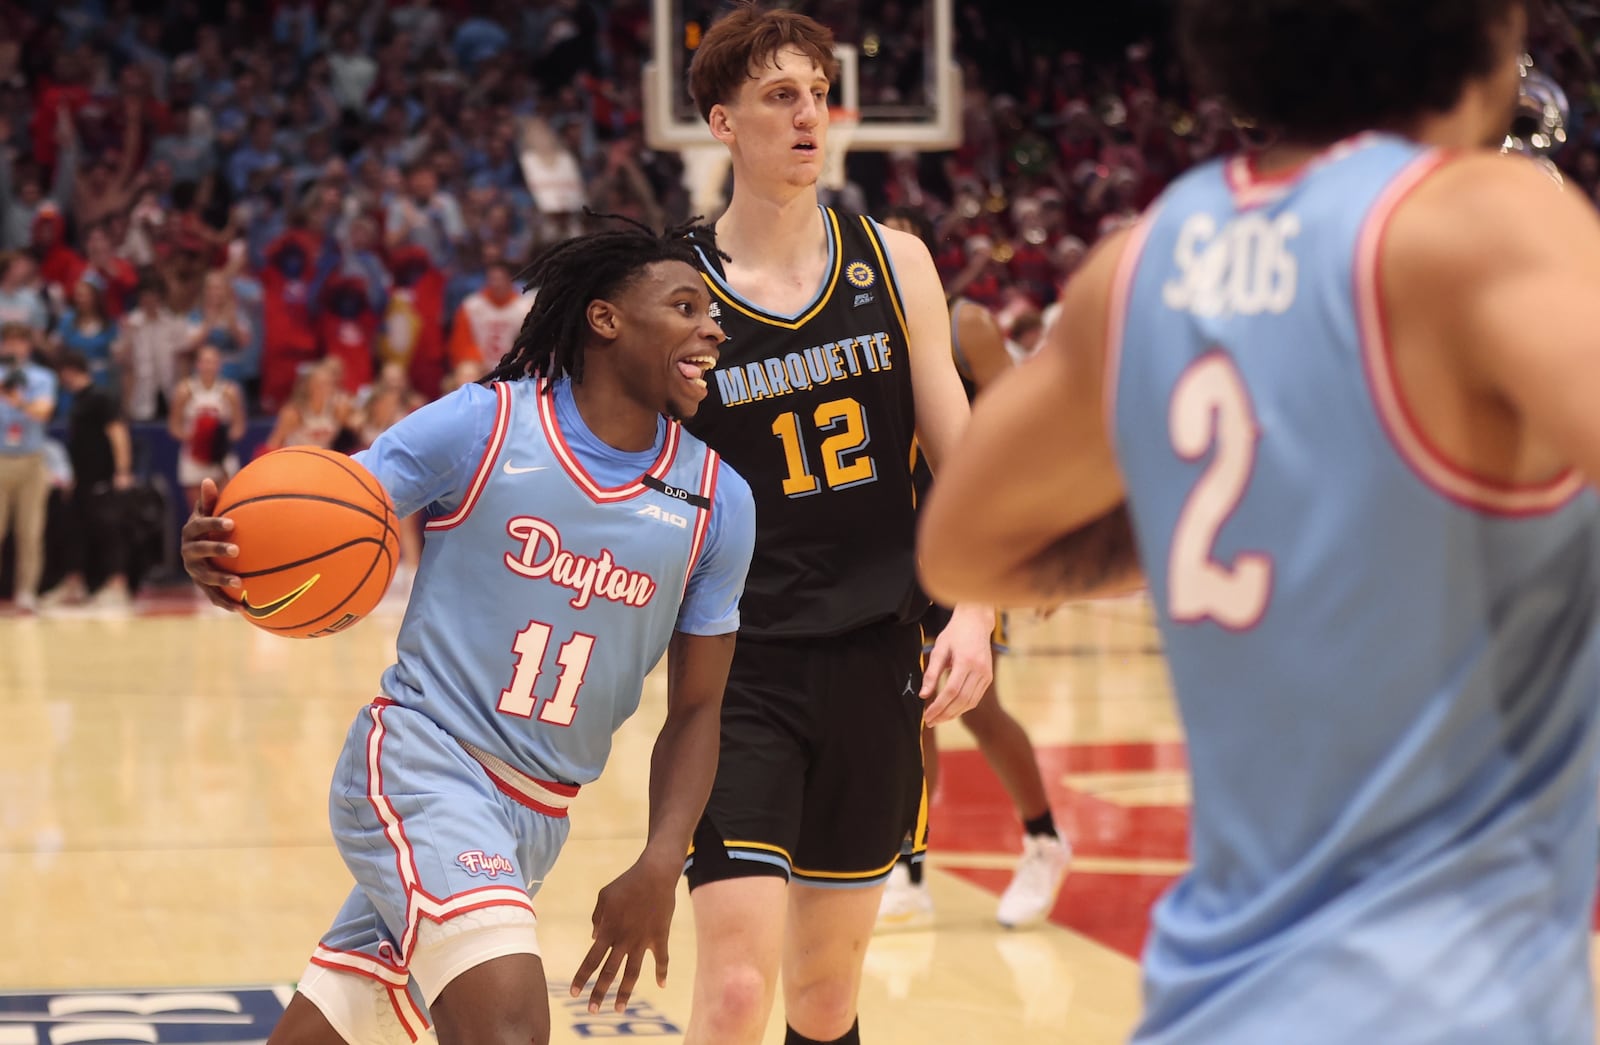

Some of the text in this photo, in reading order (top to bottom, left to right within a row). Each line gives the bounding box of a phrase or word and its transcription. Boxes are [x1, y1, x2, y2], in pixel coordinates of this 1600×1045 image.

[714, 331, 892, 408] MARQUETTE
[664, 485, 688, 500] DJD
[771, 397, 878, 499] 12
[1168, 348, 1276, 632] 2
[504, 515, 656, 608] Dayton
[496, 619, 597, 727] 11
[458, 849, 514, 877] Flyers
